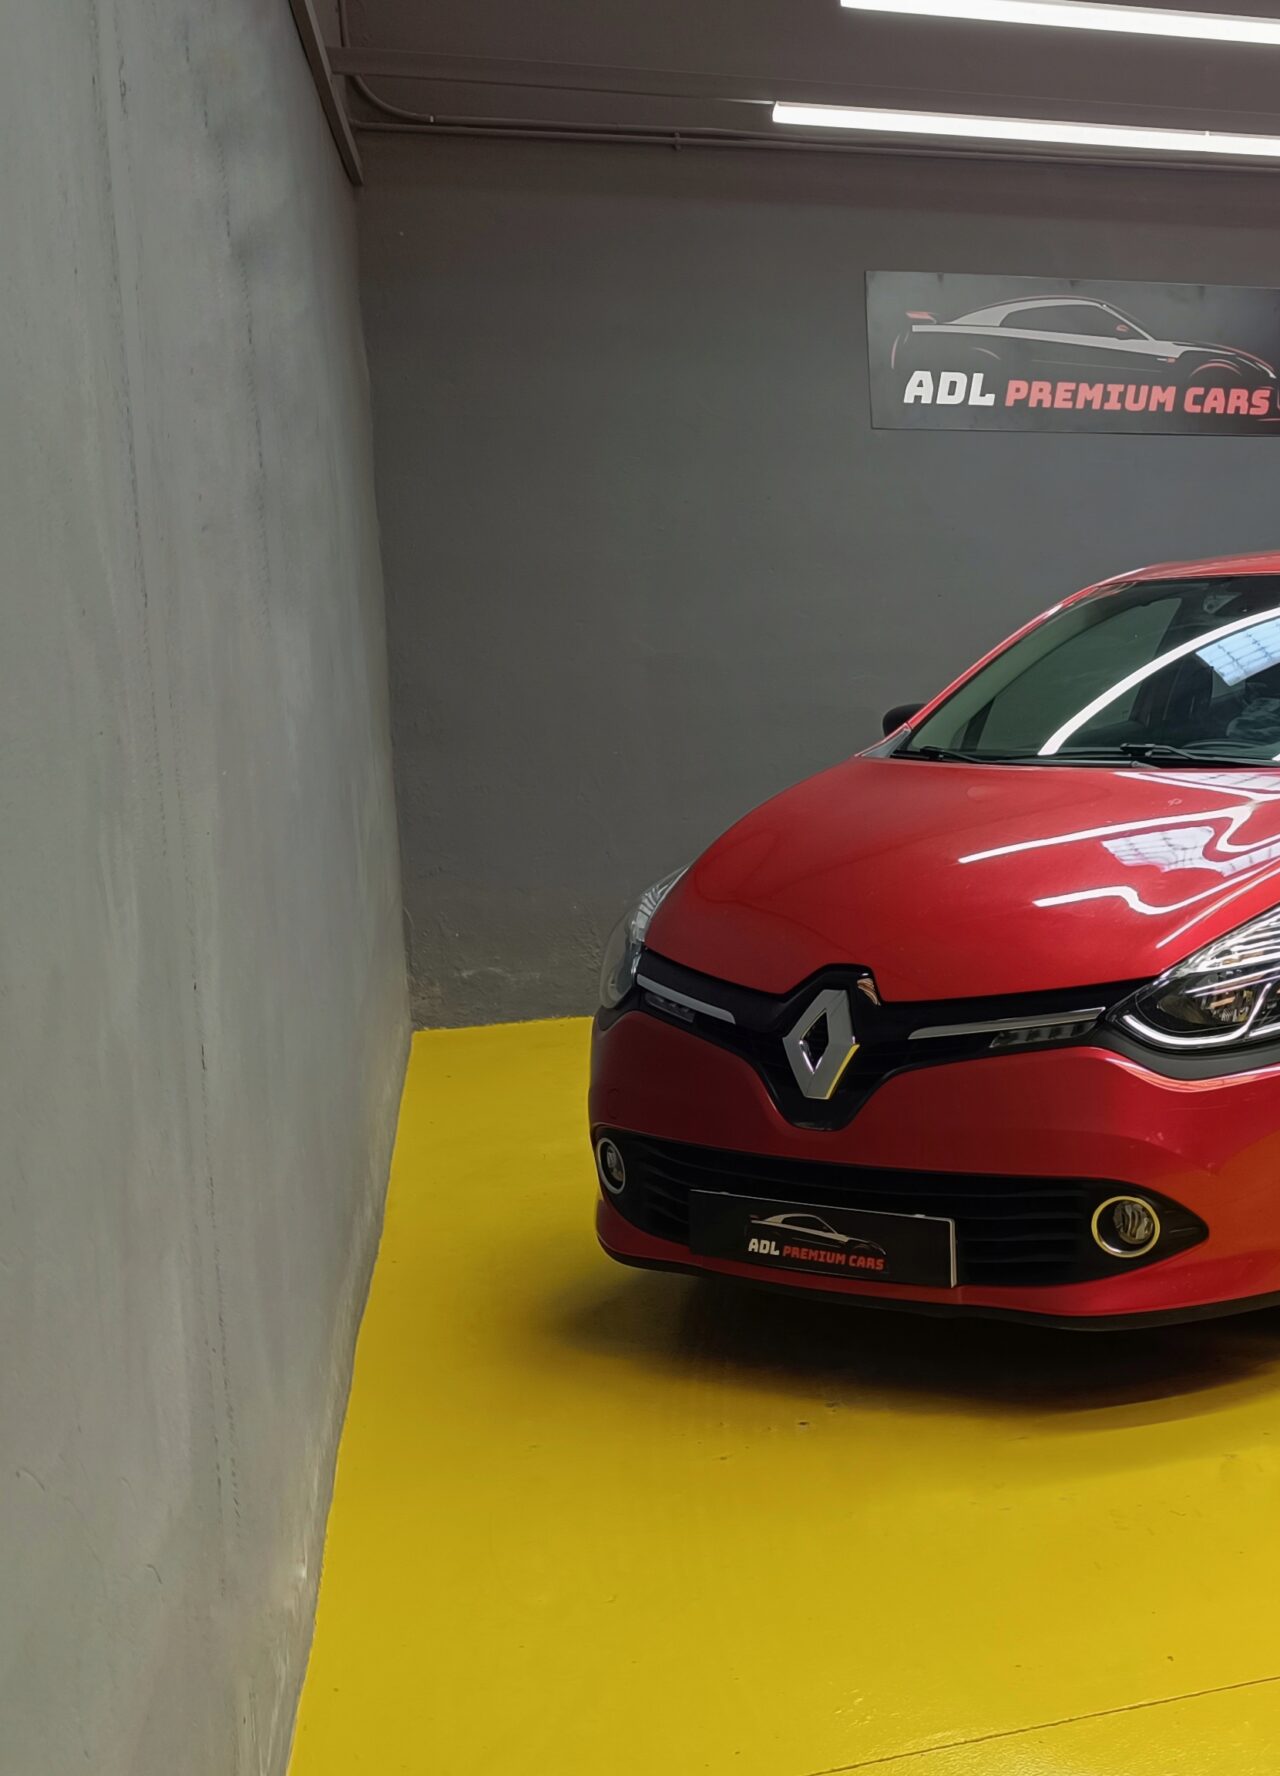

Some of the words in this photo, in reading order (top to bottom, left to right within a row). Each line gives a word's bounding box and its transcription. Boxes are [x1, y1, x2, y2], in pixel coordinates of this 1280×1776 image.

[903, 370, 996, 406] ADL
[1005, 379, 1177, 413] PREMIUM
[1183, 386, 1271, 416] CARS
[748, 1238, 780, 1256] ADL
[782, 1245, 846, 1265] PREMIUM
[849, 1255, 885, 1271] CARS
